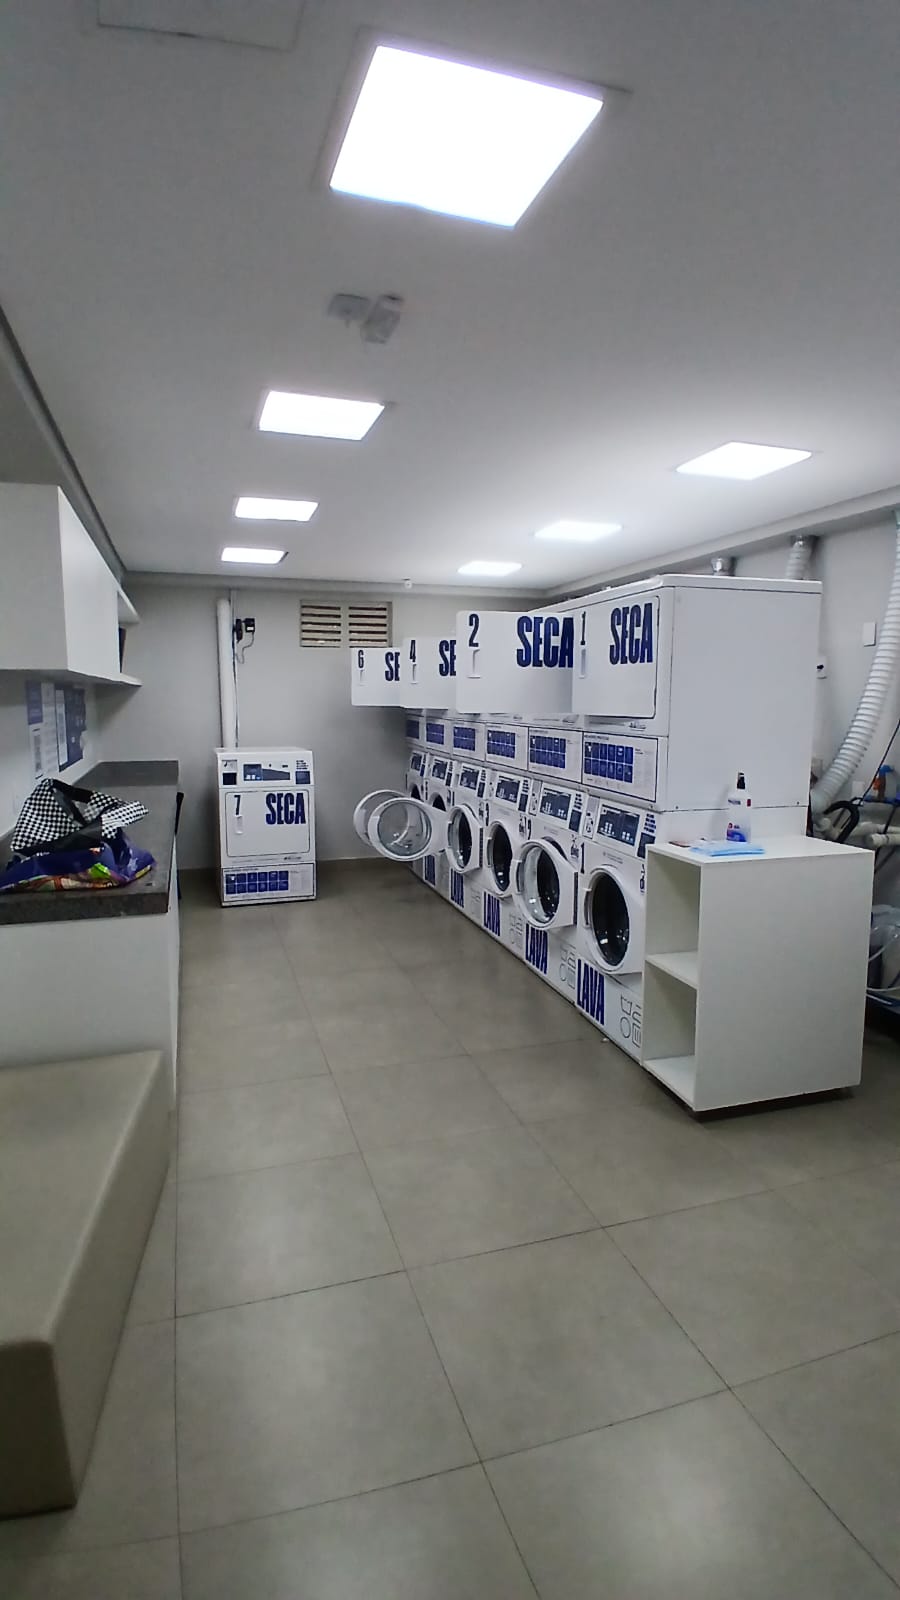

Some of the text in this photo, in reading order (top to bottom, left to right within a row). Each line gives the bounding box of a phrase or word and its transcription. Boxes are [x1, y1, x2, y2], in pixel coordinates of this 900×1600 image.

[409, 639, 417, 663] 4
[468, 613, 574, 668] 2 SECA
[580, 602, 654, 665] 1 SECA
[357, 649, 365, 669] 6
[234, 792, 307, 825] 7 SECA
[483, 891, 501, 937] LAVA
[525, 923, 548, 975] LAVA
[576, 958, 605, 1026] LAVA
